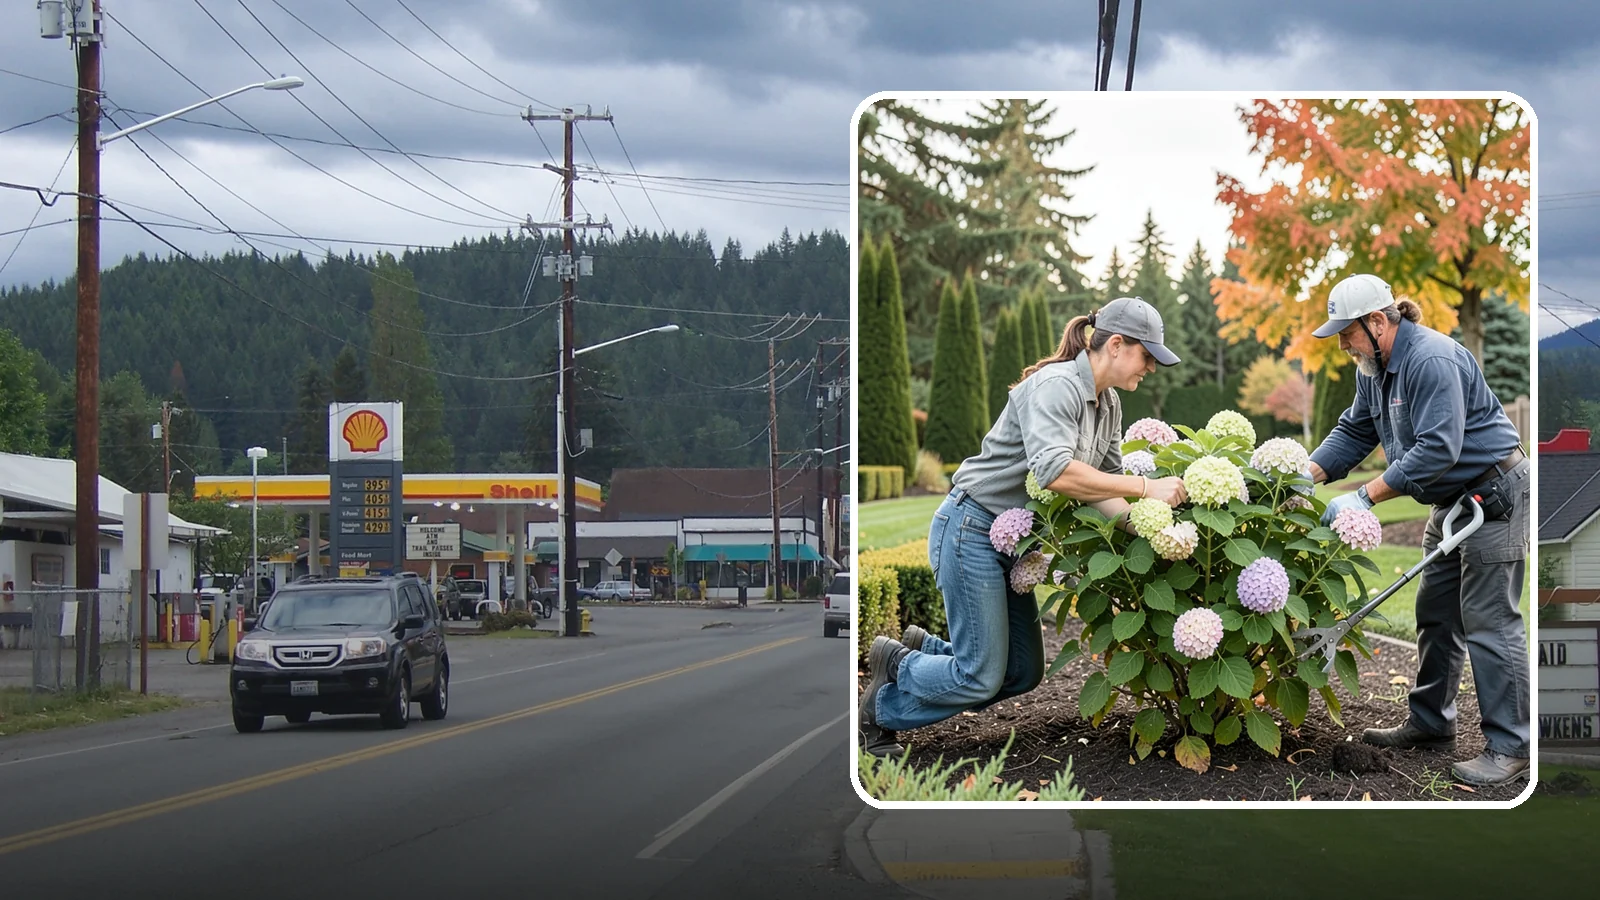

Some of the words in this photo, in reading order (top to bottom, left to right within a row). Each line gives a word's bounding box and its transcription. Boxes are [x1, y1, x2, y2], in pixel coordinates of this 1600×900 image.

[366, 480, 384, 490] 395
[490, 484, 547, 499] Shell
[366, 494, 384, 504] 405
[366, 508, 384, 518] 415
[366, 522, 384, 532] 429
